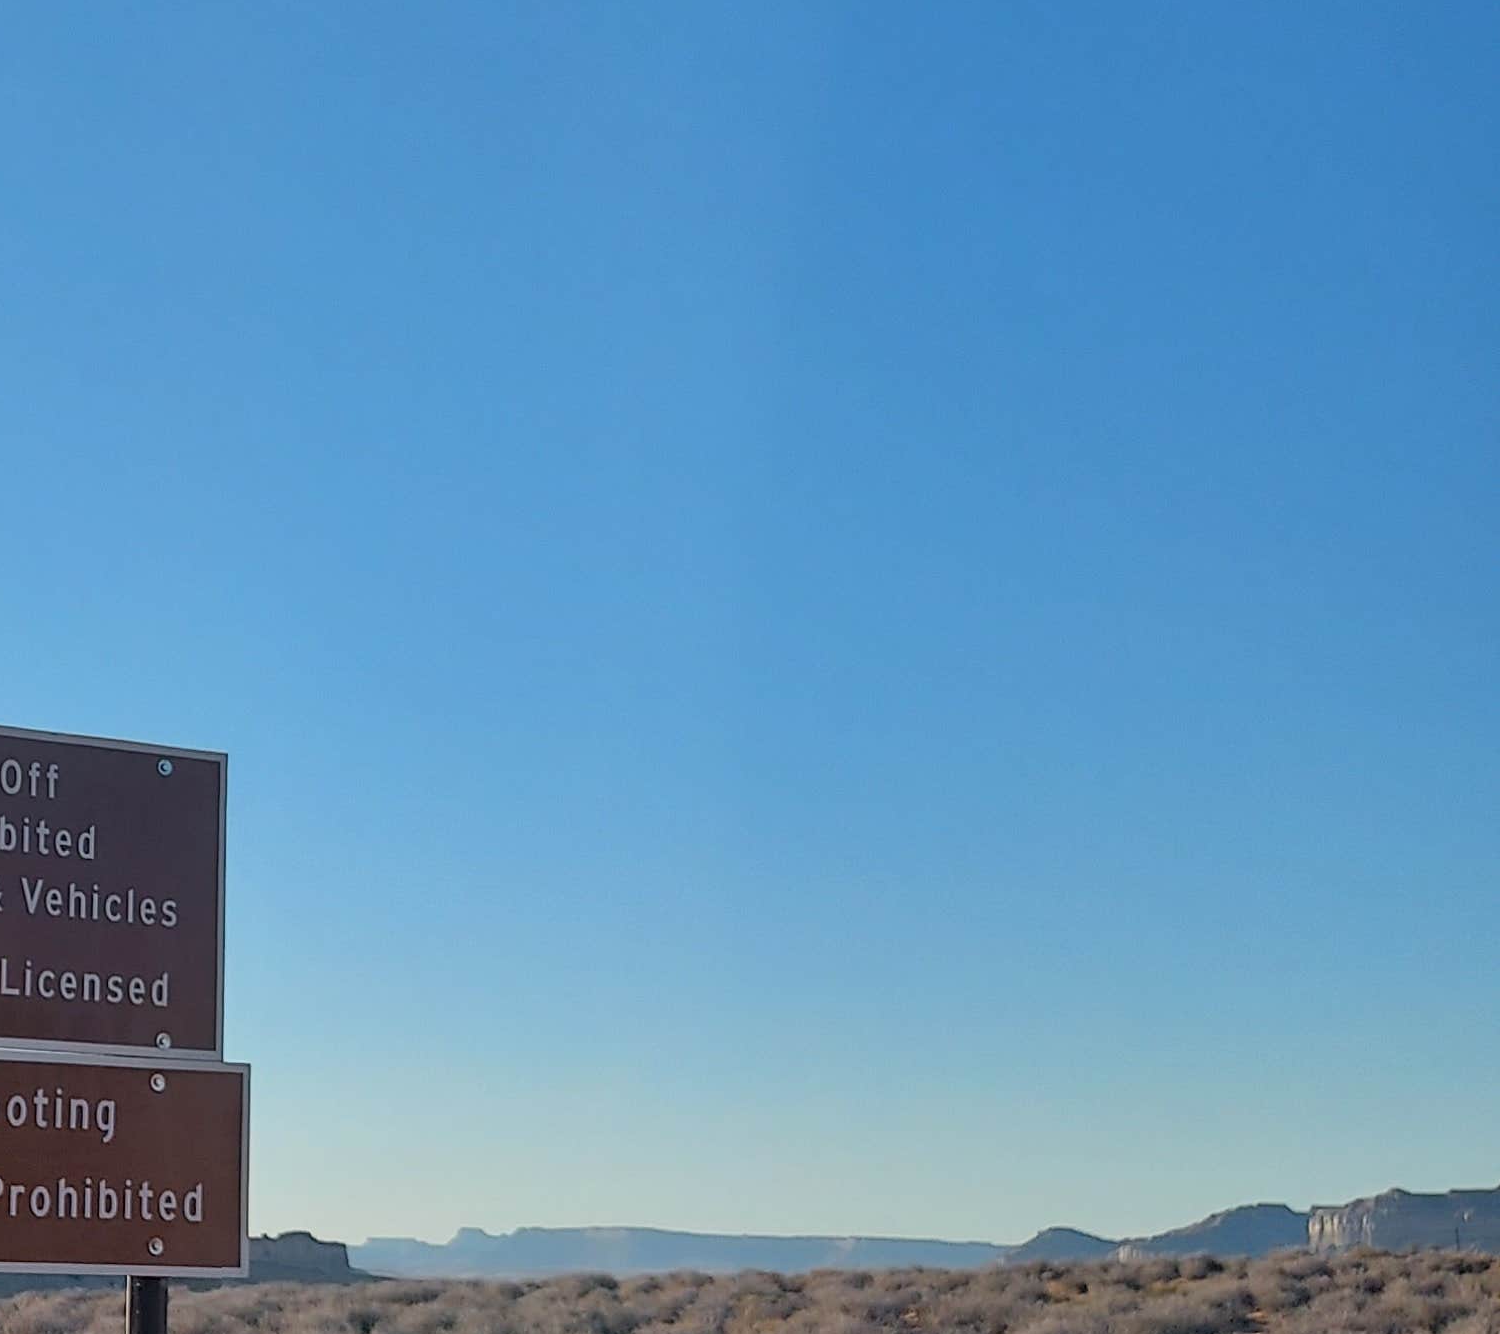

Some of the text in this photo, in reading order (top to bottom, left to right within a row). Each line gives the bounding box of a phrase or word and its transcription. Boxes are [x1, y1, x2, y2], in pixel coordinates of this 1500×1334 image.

[1, 759, 58, 798] Off
[21, 877, 177, 927] Vehicles
[1, 958, 168, 1007] Licensed
